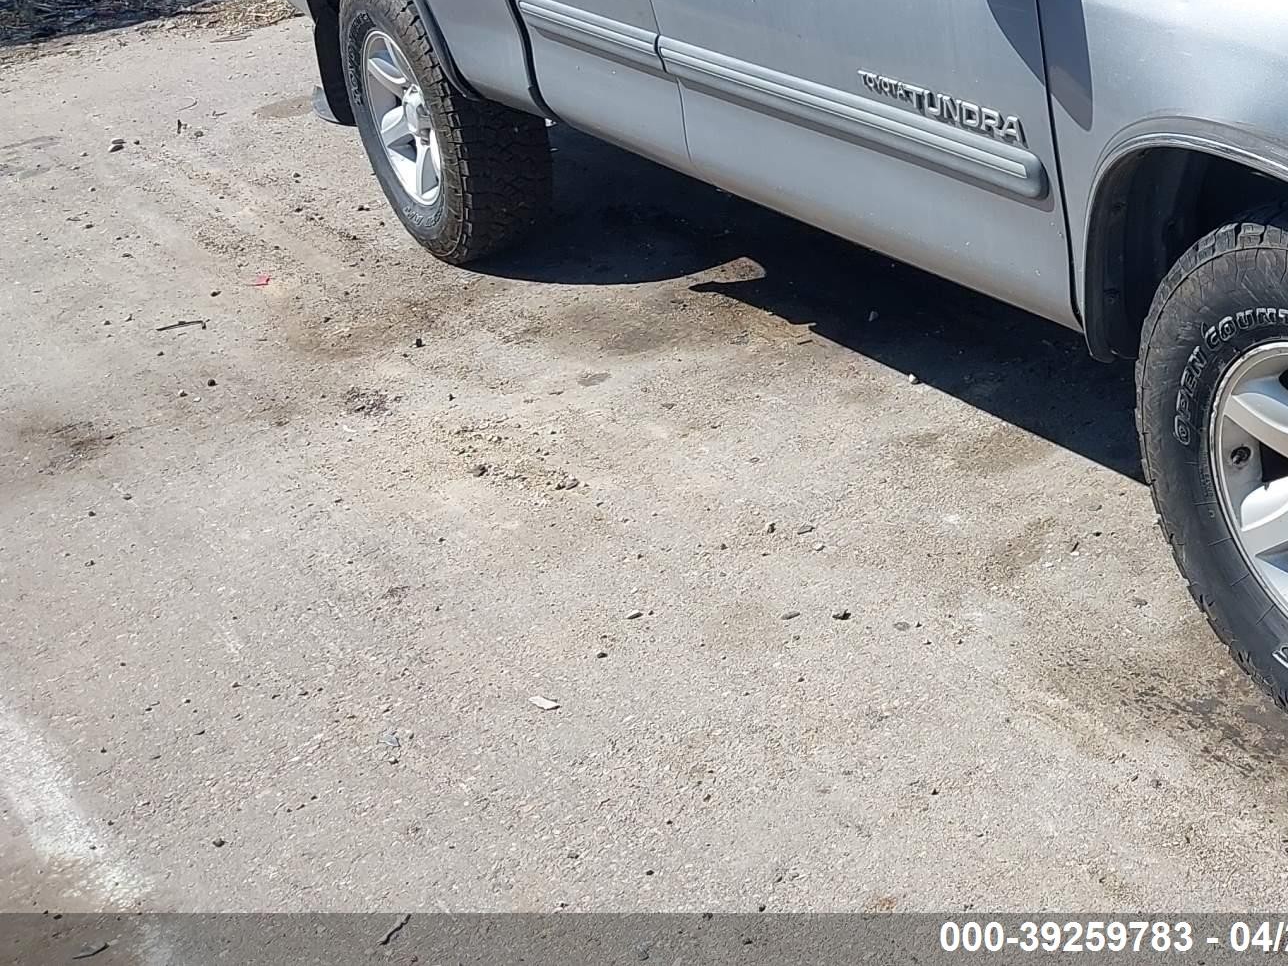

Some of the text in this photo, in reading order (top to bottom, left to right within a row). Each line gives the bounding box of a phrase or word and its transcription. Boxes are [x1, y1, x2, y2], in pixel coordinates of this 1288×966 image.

[857, 68, 1028, 146] TOYOTA TUNDRA
[1173, 345, 1208, 446] OPEN
